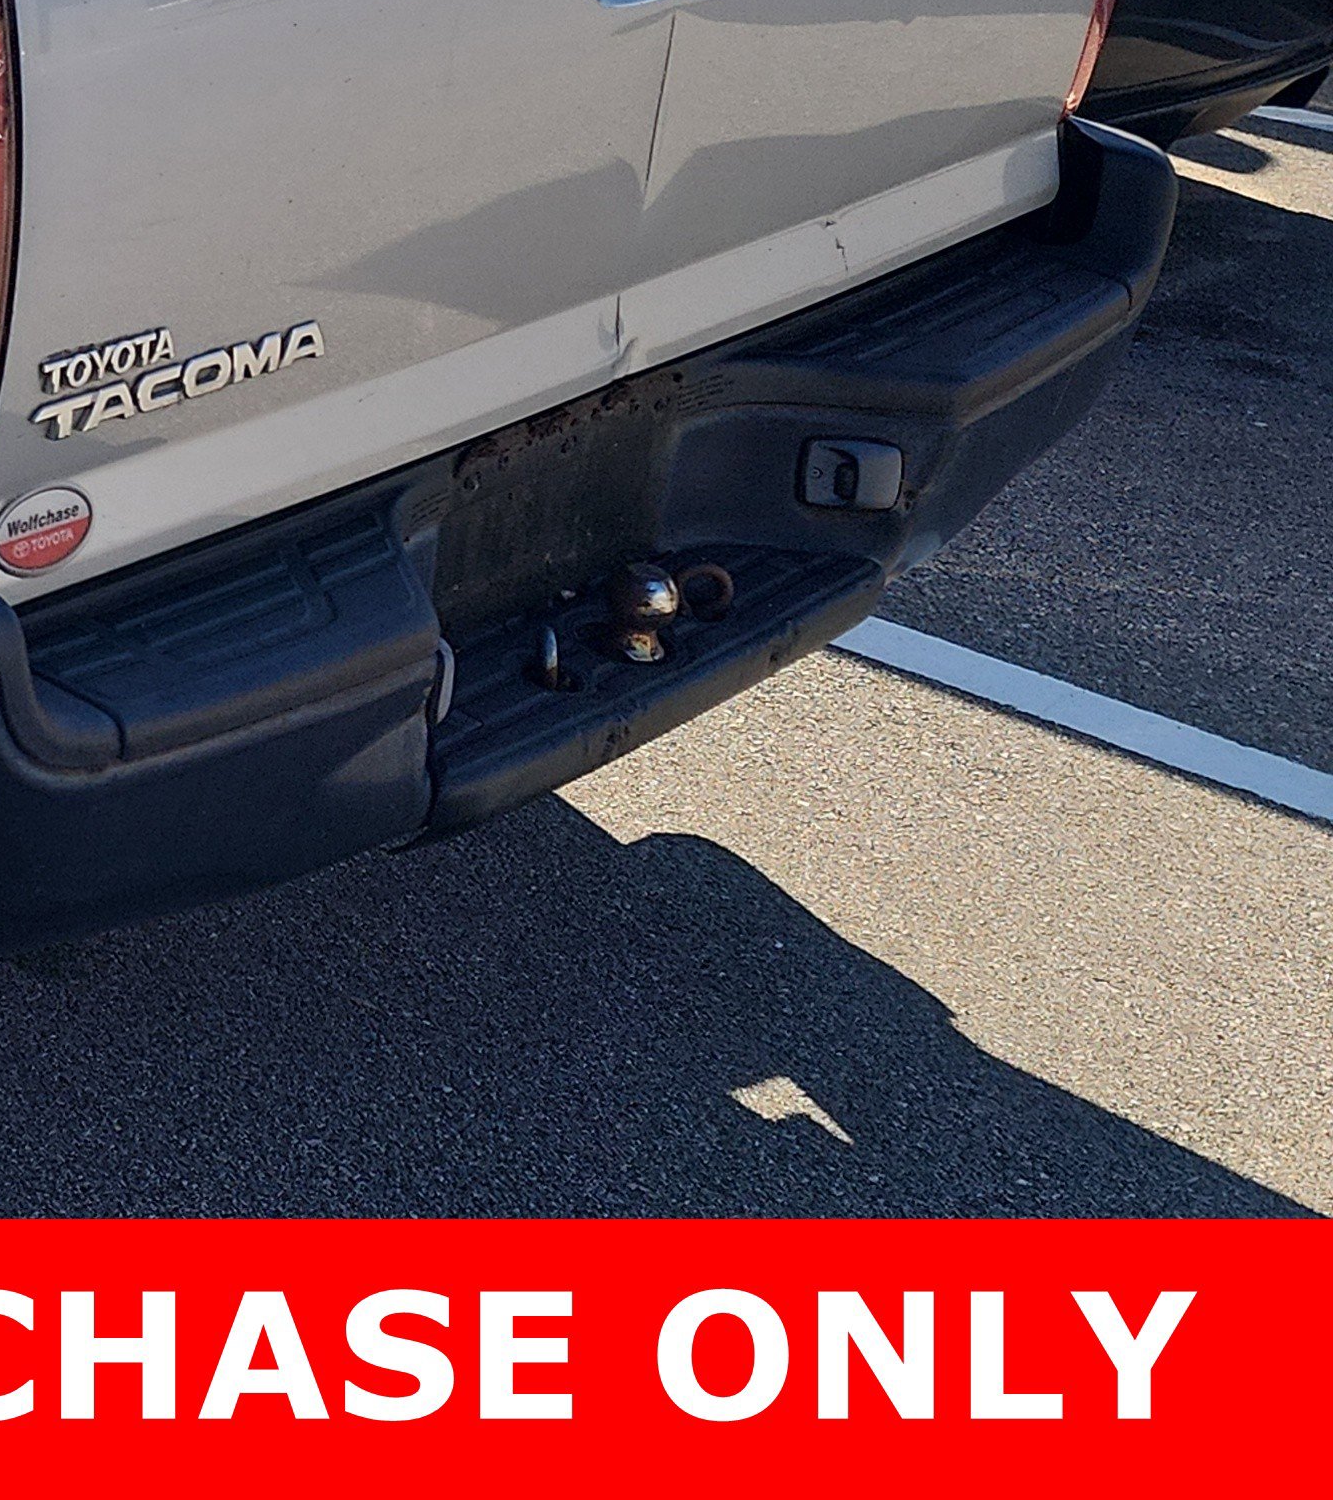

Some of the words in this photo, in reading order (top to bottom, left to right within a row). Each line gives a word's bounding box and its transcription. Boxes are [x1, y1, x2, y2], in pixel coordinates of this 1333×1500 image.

[30, 319, 325, 441] TACOMA
[39, 327, 176, 394] TOYOTA
[6, 502, 81, 538] Wolfchase
[31, 528, 75, 552] TOYOTA
